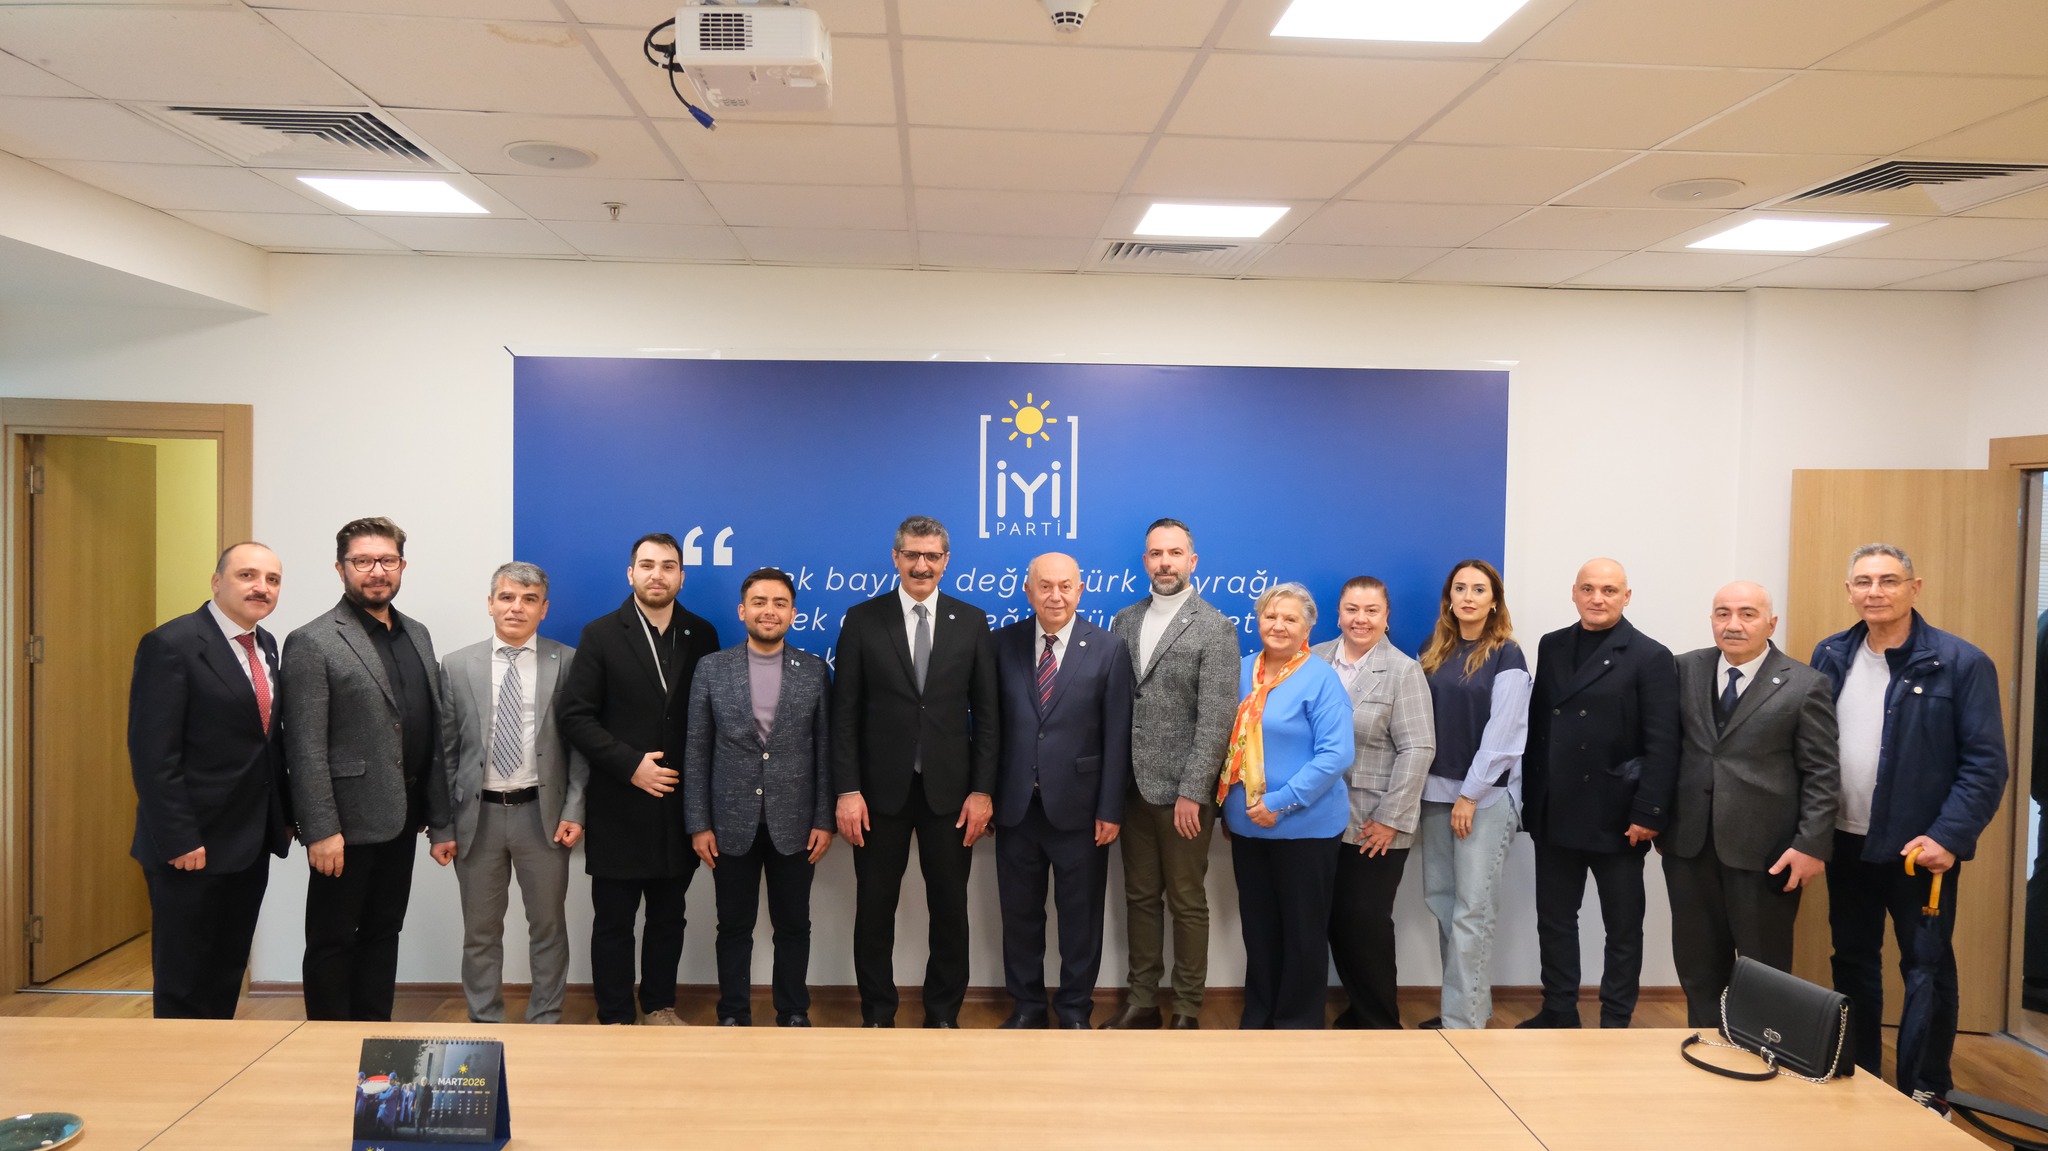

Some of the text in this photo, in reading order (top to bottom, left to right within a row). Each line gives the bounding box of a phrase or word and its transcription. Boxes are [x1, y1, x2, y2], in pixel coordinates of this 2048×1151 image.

[996, 519, 1061, 536] PARTİ
[791, 607, 828, 631] ek
[437, 1077, 486, 1087] MART2026
